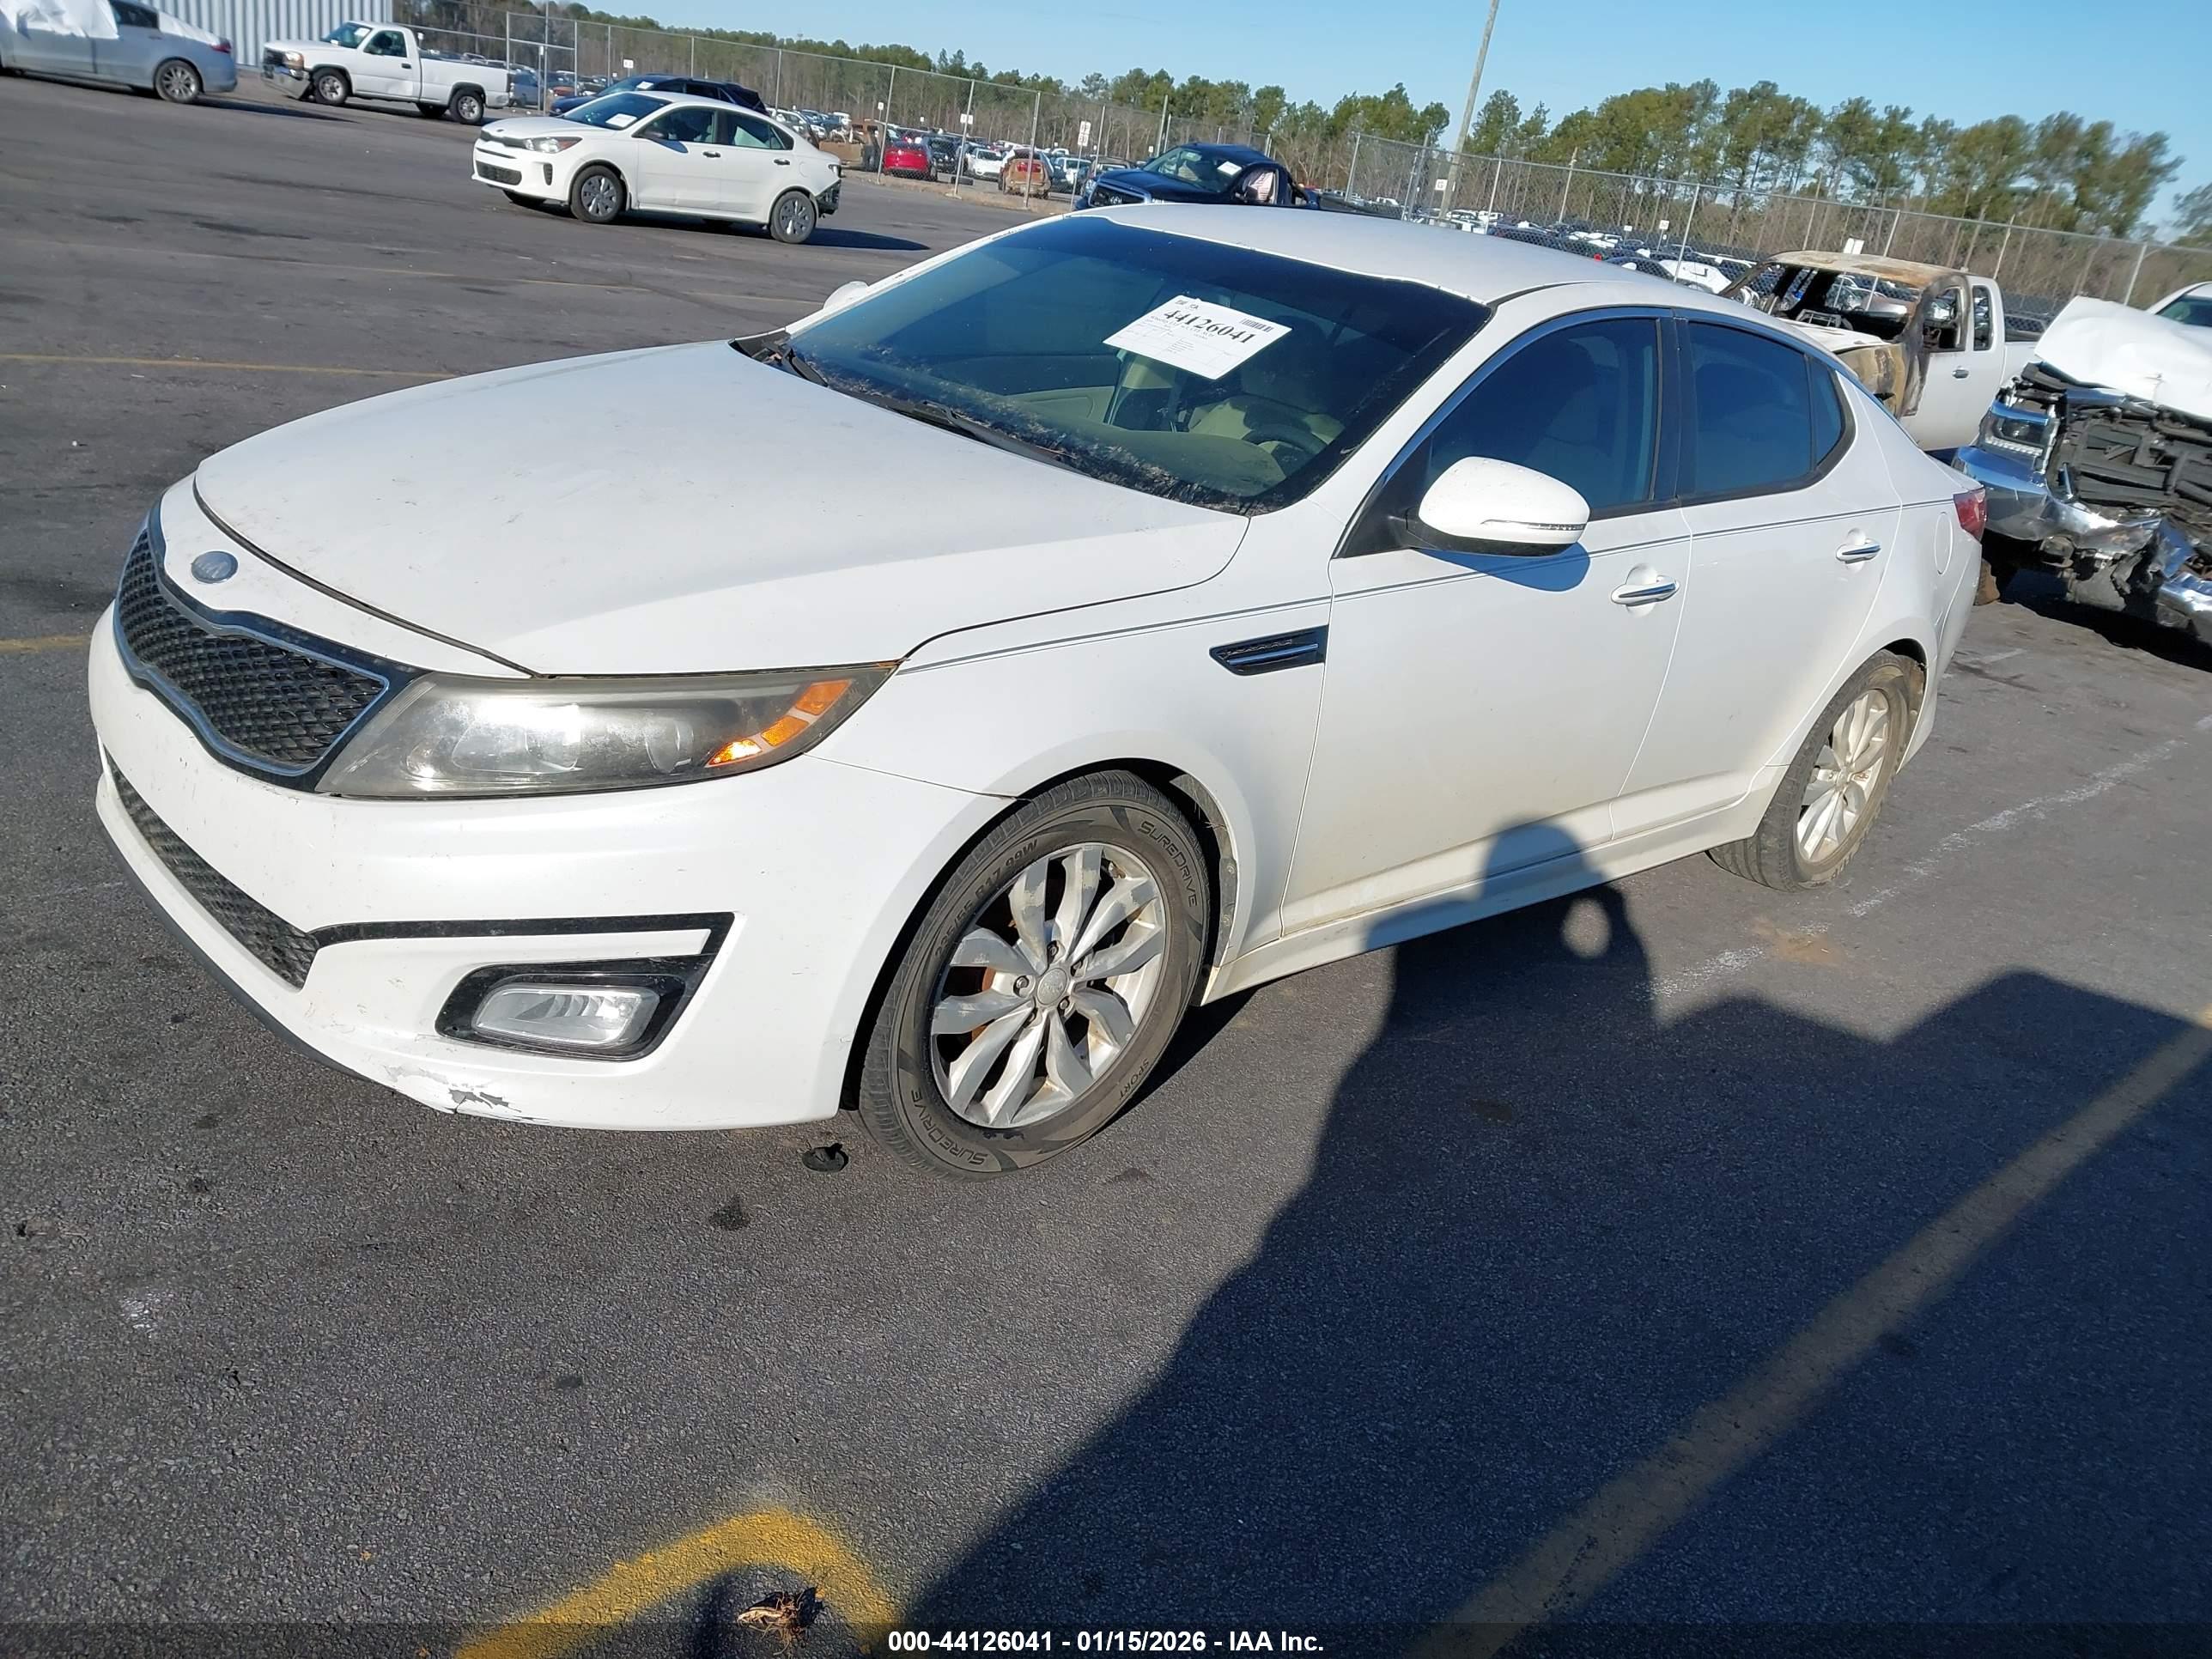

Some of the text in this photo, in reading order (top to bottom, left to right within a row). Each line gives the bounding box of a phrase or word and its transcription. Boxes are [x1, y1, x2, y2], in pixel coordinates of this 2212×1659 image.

[1163, 310, 1255, 343] 44126041
[1138, 820, 1198, 908] SUREDRIVE
[910, 1087, 988, 1166] SUREDRIVE
